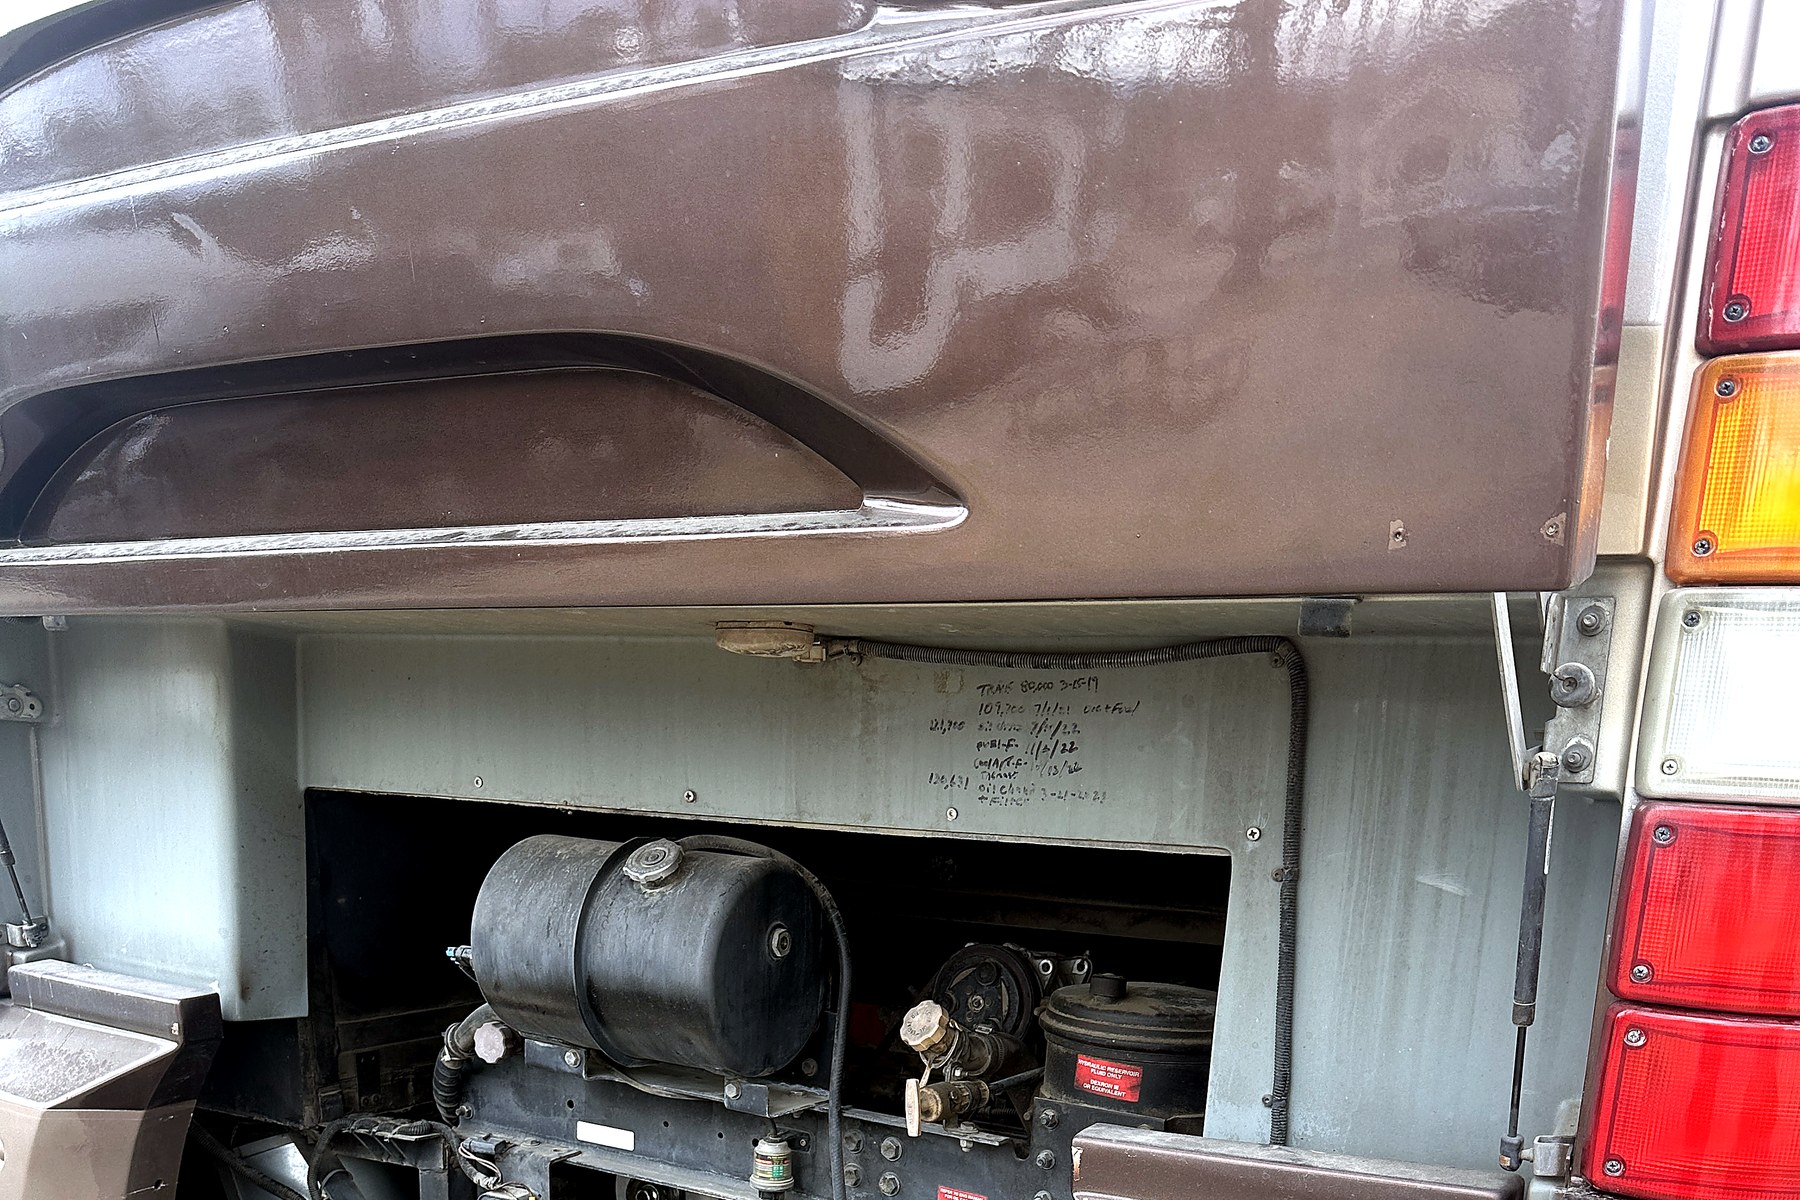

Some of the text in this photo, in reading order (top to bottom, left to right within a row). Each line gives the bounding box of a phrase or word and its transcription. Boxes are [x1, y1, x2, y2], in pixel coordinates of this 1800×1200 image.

[1077, 1059, 1140, 1077] HYDRAULIC RESERVOIR
[1090, 1068, 1106, 1076] FLUID
[1090, 1079, 1113, 1089] DEXRON
[1091, 1085, 1126, 1097] EQUIVALENT
